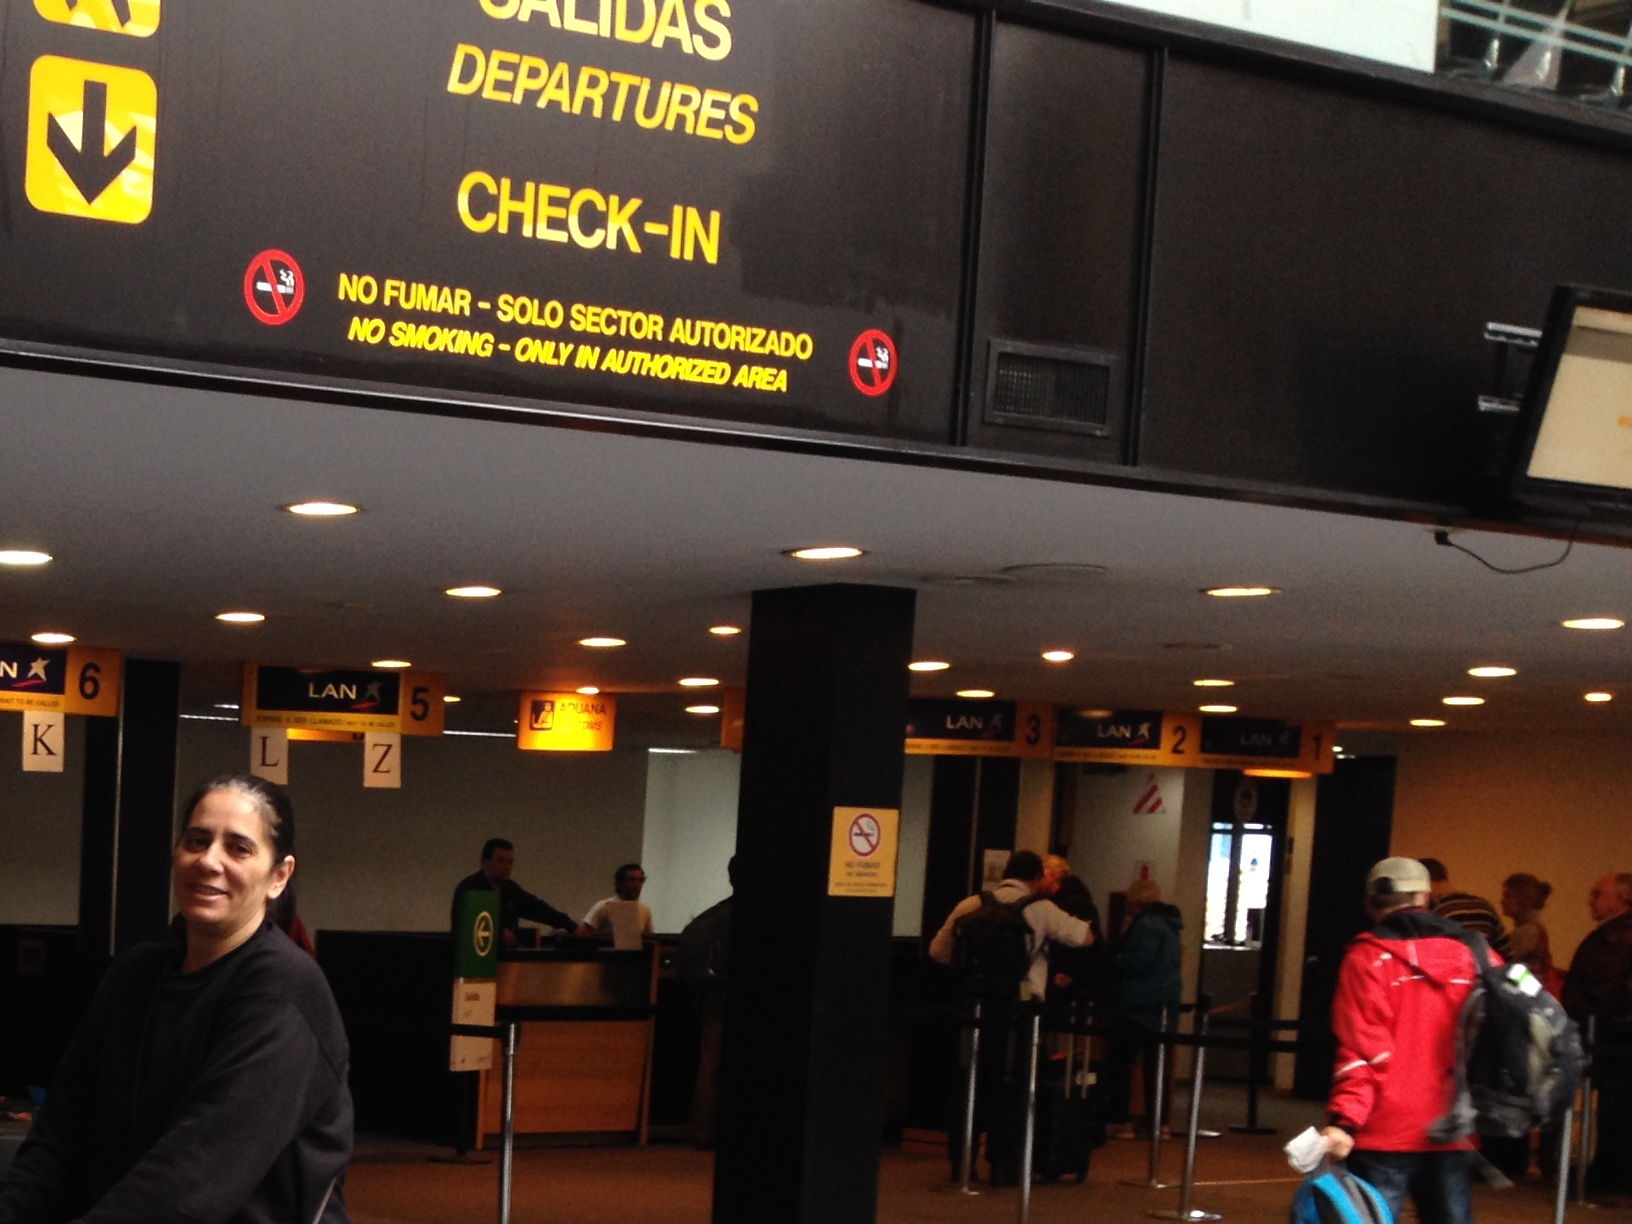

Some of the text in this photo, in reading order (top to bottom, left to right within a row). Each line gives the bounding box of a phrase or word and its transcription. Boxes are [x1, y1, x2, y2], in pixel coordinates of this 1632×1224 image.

[447, 43, 759, 144] DEPARTURES
[457, 171, 721, 264] CHECK-IN
[338, 273, 378, 304] NO
[384, 279, 472, 317] FUMAR
[497, 294, 564, 329] SOLO
[569, 303, 664, 341] SECTOR
[669, 317, 814, 360] AUTORIZADO
[347, 316, 386, 344] NO
[389, 321, 495, 358] SMOKING
[514, 337, 574, 367] ONLY
[574, 345, 601, 369] IN
[601, 349, 732, 385] AUTHORIZED
[732, 364, 788, 393] AREA
[79, 662, 101, 700] 6
[308, 682, 358, 700] LAN
[410, 686, 430, 721] 5
[945, 710, 984, 729] LAN
[31, 723, 58, 756] K
[1026, 714, 1042, 745] 3
[1096, 724, 1132, 739] LAN
[1171, 725, 1186, 755] 2
[260, 736, 280, 768] L
[371, 743, 394, 774] Z
[1312, 732, 1322, 761] 1
